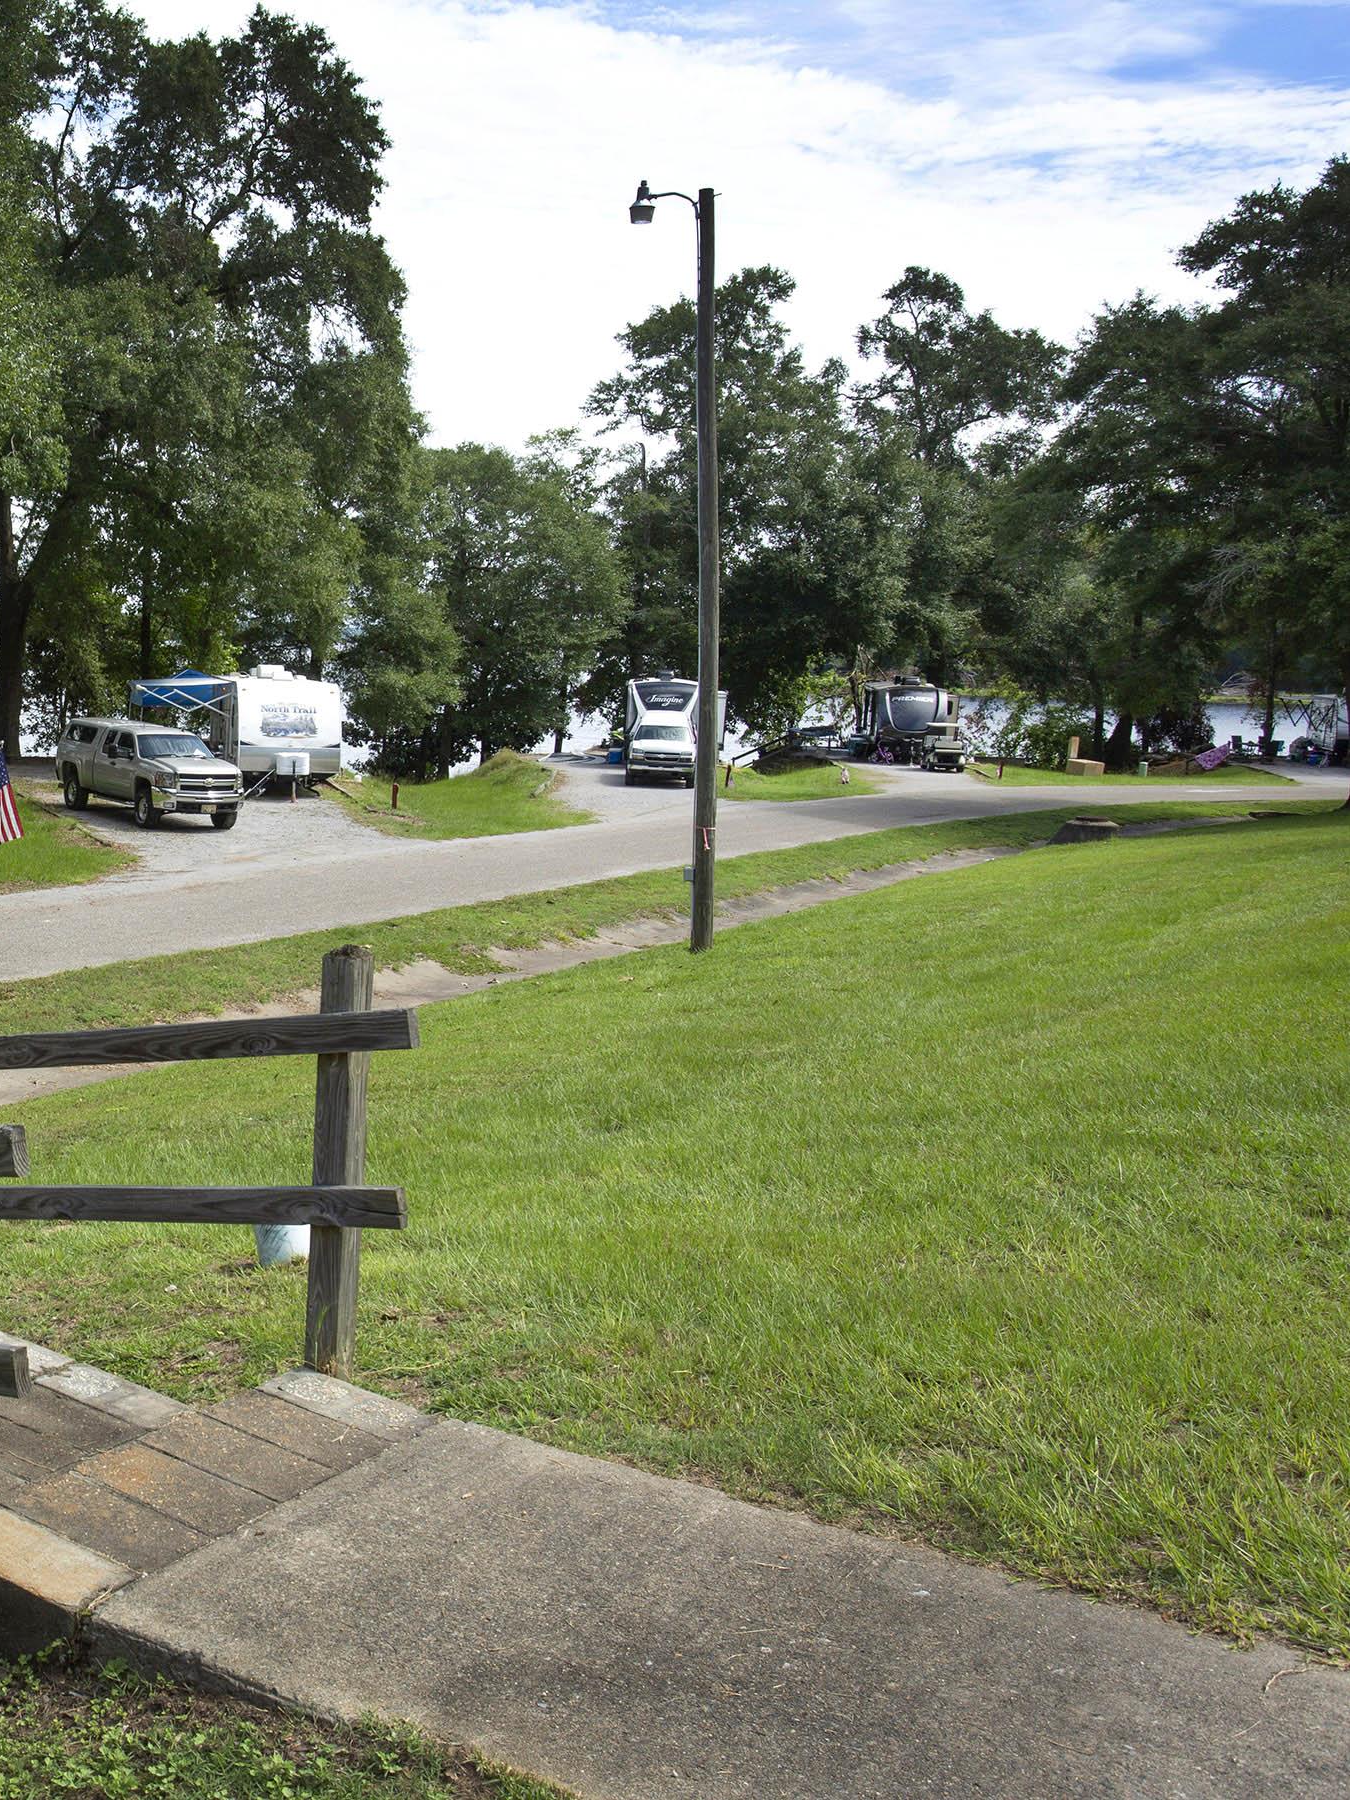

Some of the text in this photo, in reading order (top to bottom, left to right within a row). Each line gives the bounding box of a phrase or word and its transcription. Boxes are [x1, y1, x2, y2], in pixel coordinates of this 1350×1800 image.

[646, 694, 684, 707] Imagine
[260, 704, 317, 714] North Trail
